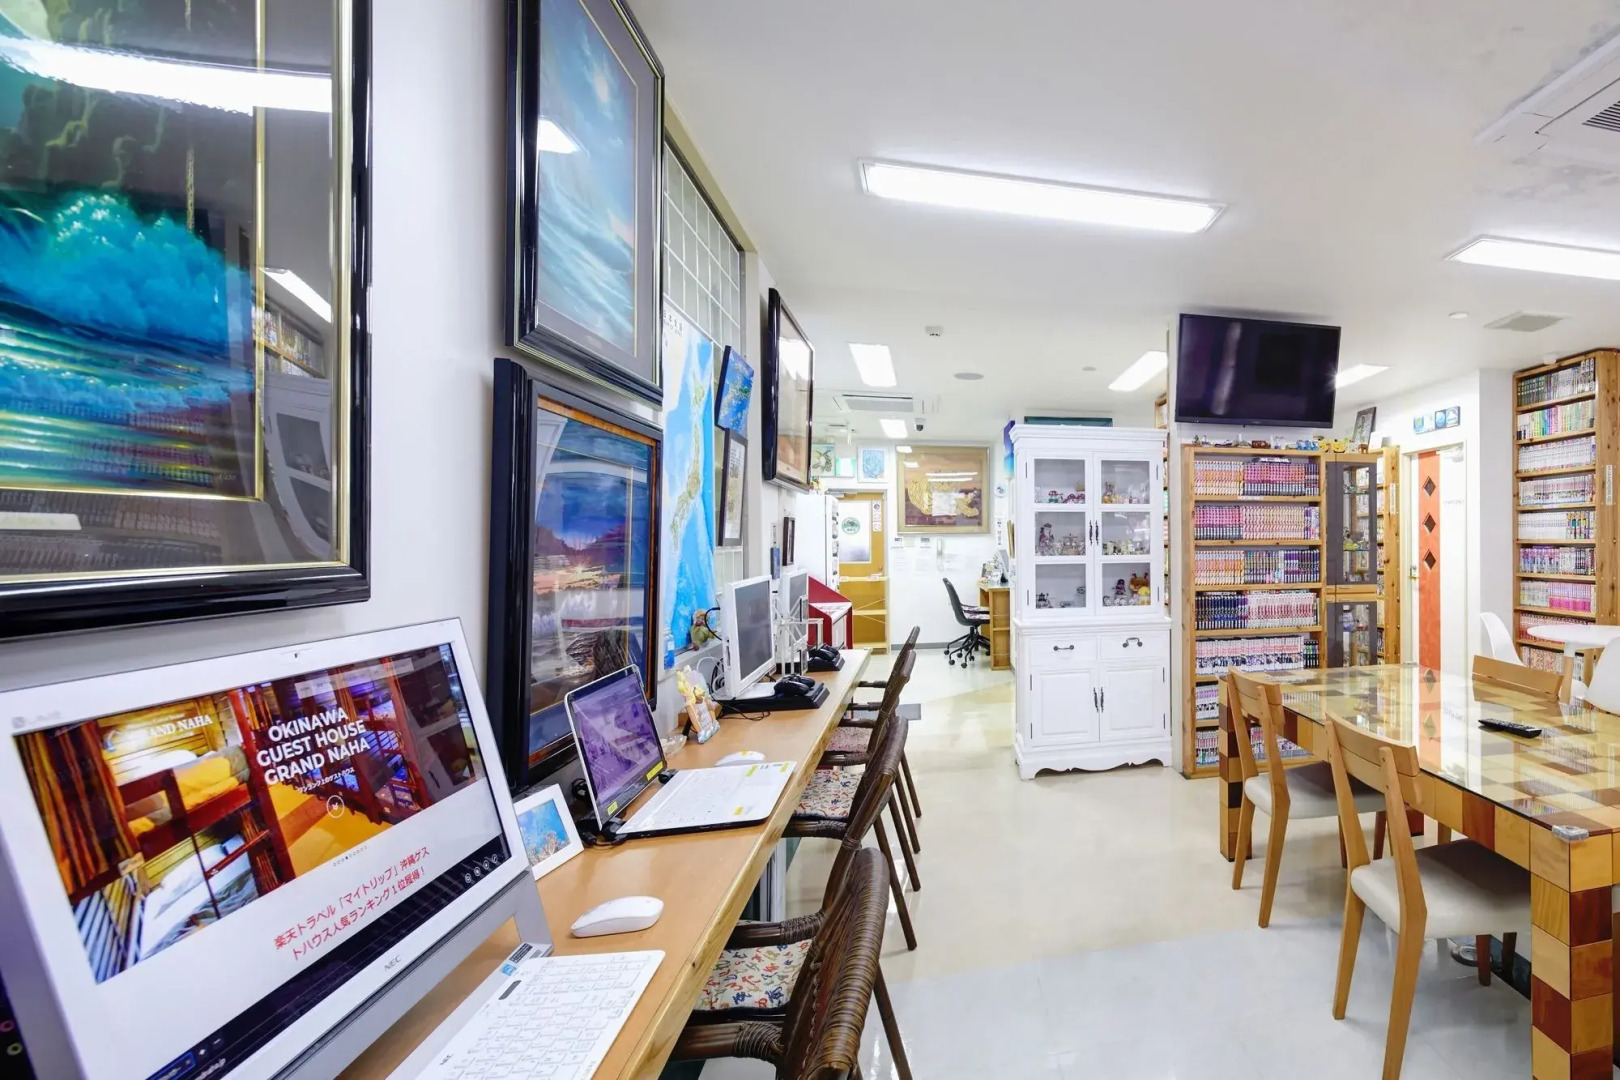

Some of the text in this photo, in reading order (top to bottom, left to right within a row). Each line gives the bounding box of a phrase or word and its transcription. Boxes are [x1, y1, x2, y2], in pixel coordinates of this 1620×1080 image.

[176, 714, 213, 732] NAHA
[268, 707, 349, 742] OKINAWA
[256, 720, 367, 767] GUEST HOUSE
[264, 739, 371, 786] GRAND NAHA
[384, 955, 402, 972] NEC
